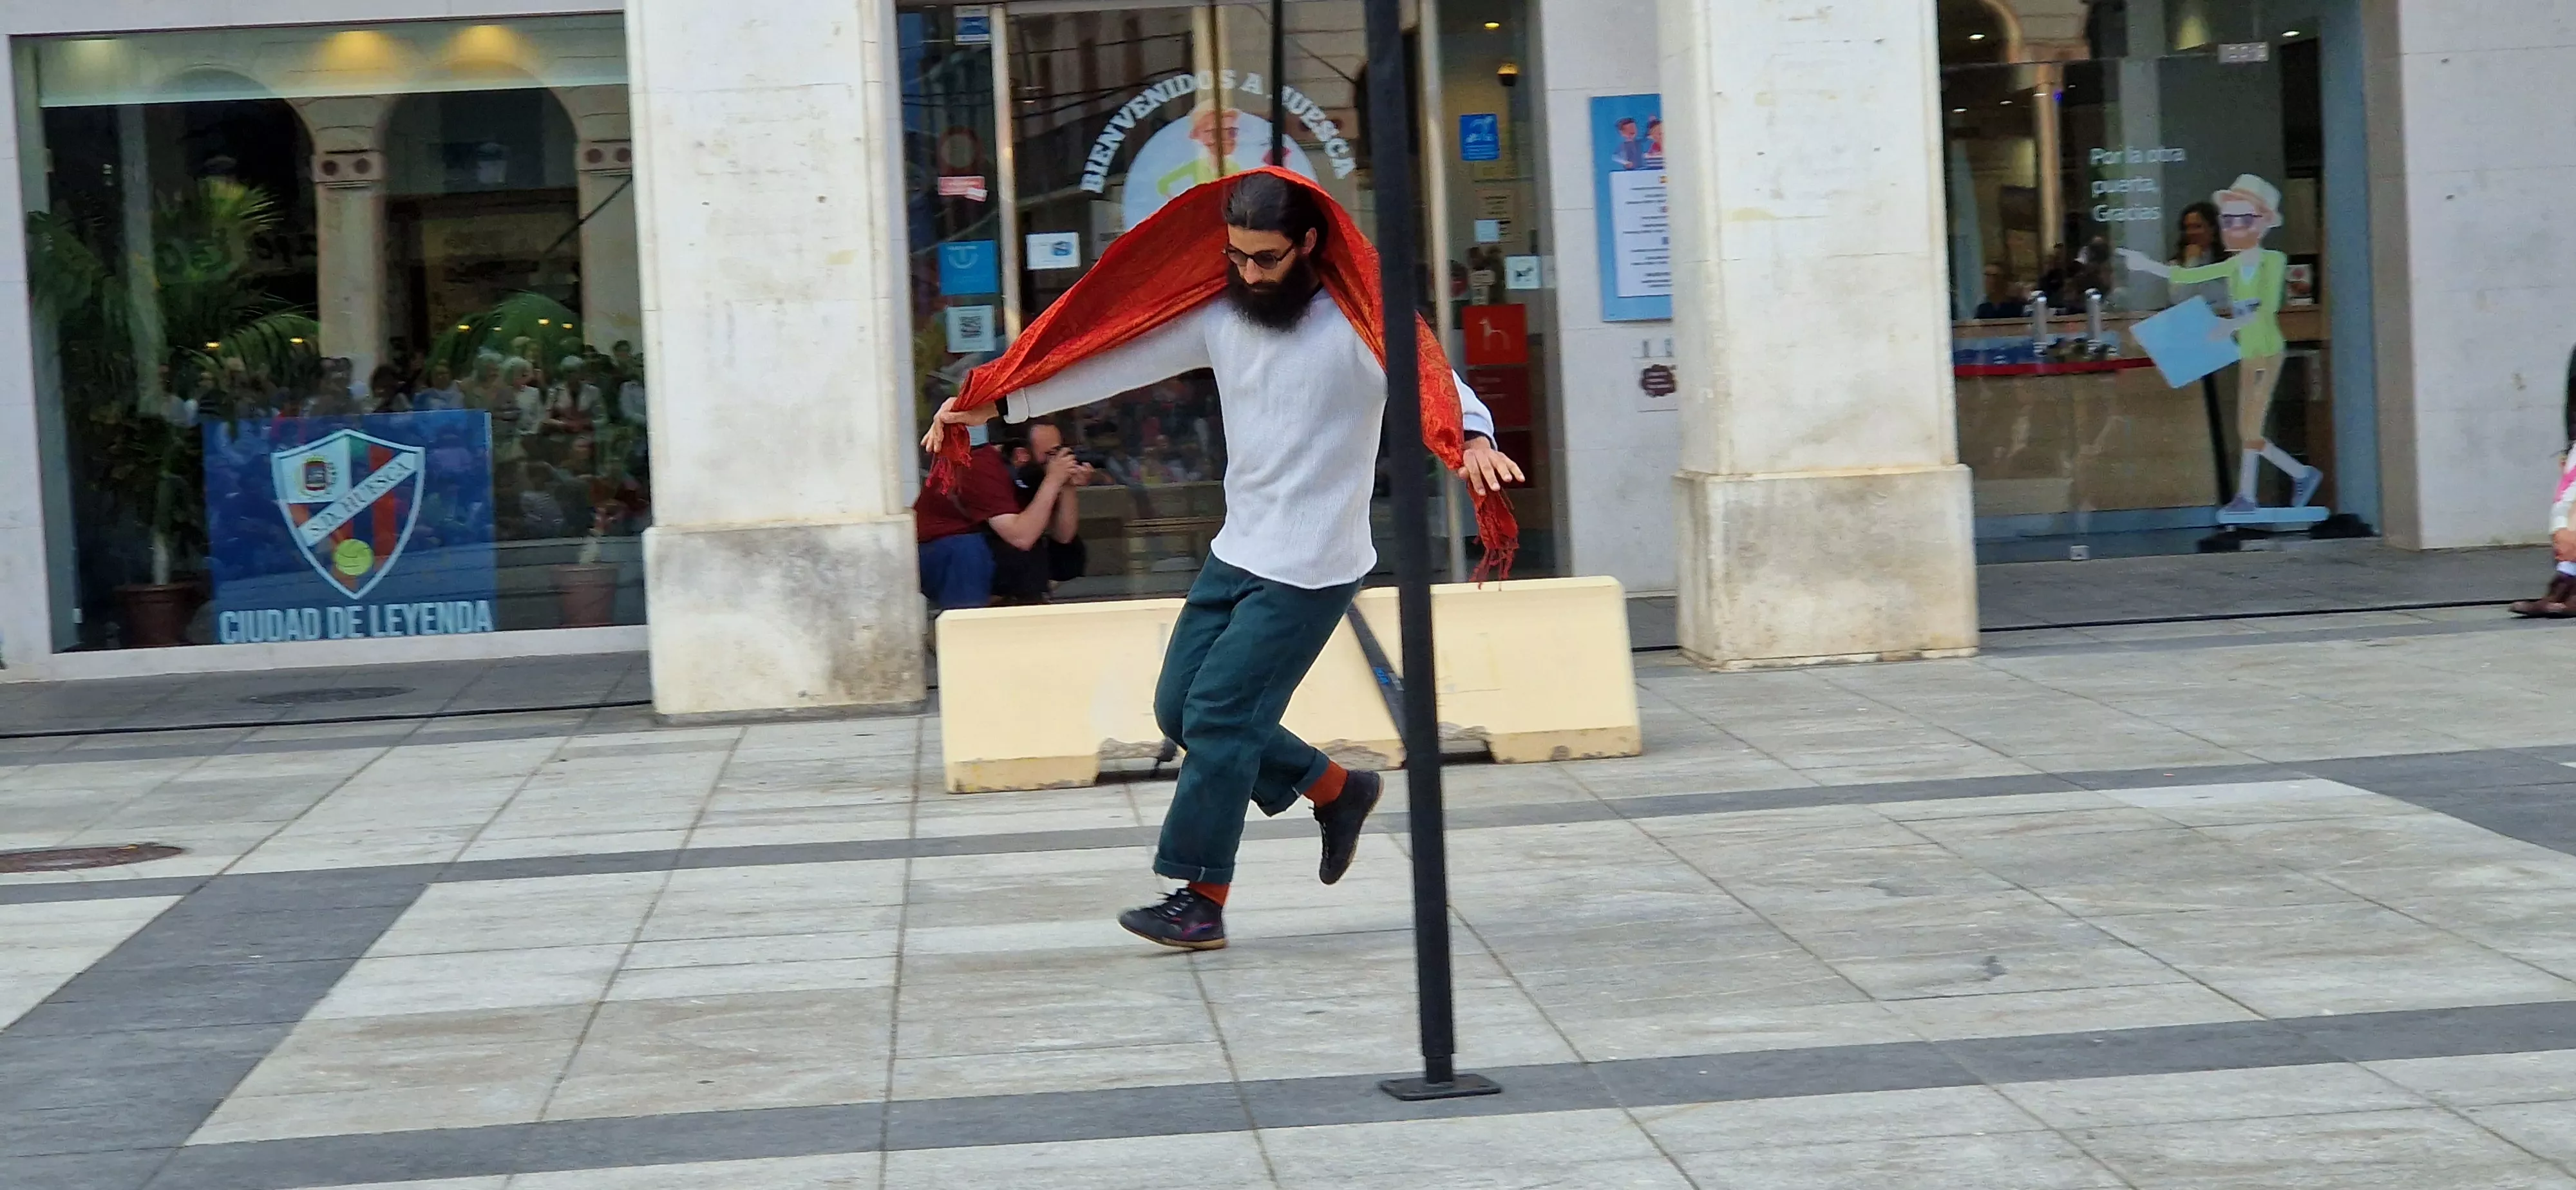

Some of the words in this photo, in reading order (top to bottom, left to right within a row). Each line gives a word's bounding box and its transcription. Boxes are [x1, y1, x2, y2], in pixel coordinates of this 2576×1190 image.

[1079, 69, 1238, 193] BIENVENIDOS
[1238, 72, 1264, 95] A
[2090, 147, 2125, 165] Por
[2126, 146, 2145, 164] la
[2146, 146, 2186, 163] otra
[2092, 203, 2162, 223] Gracias
[218, 607, 321, 643] CIUDAD
[326, 605, 365, 639] DE
[368, 600, 494, 637] LEYENDA
